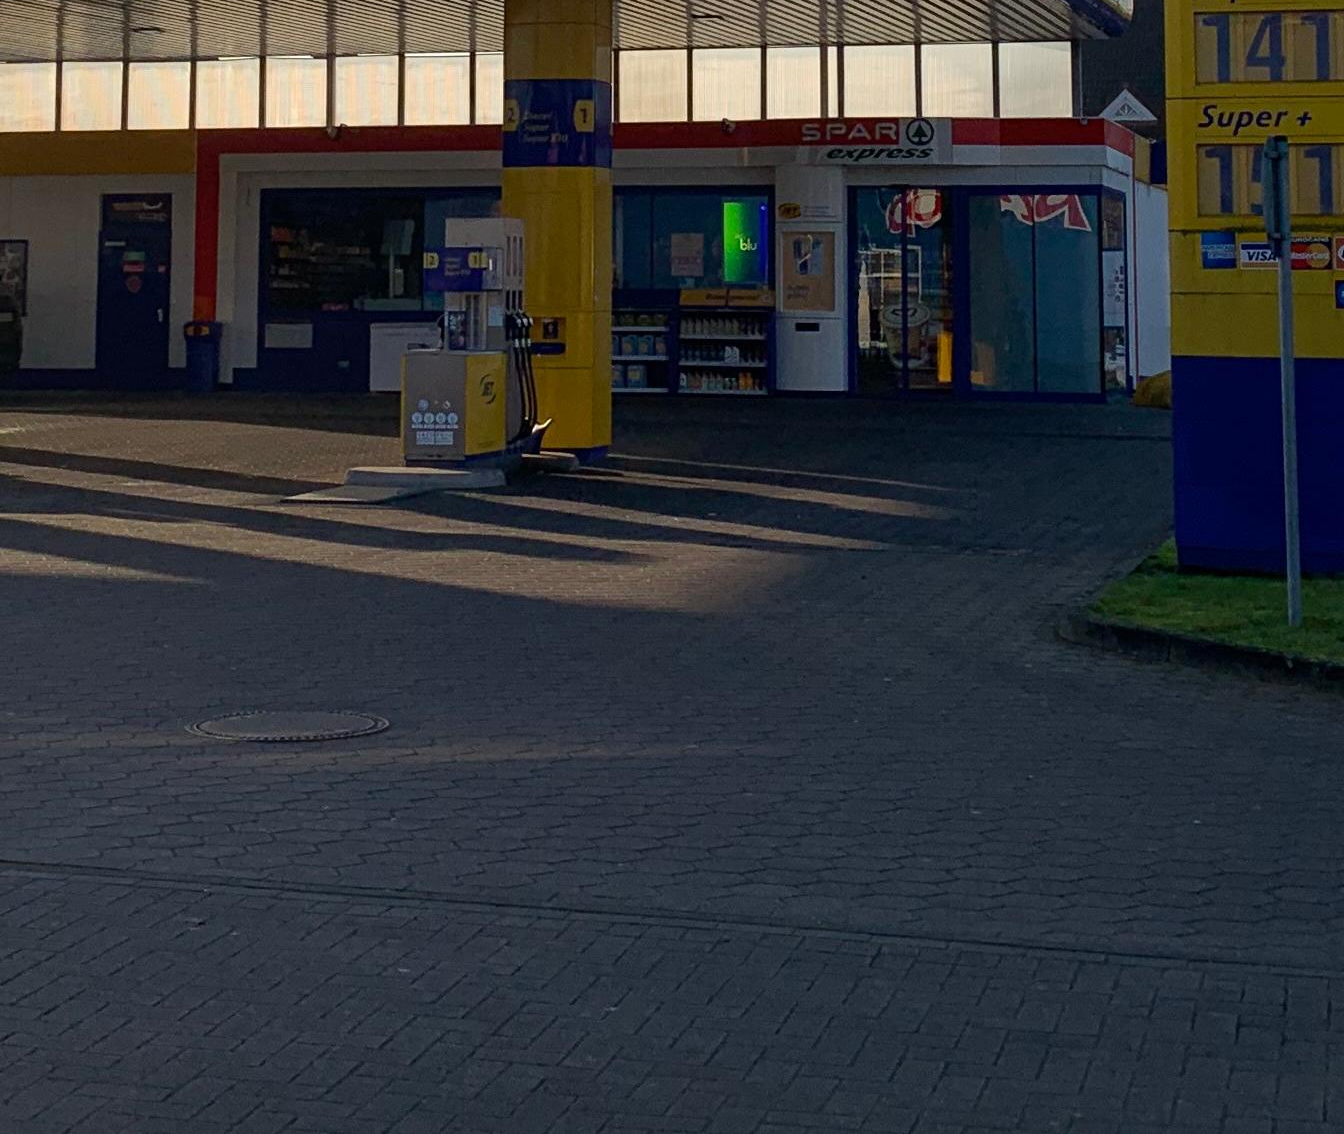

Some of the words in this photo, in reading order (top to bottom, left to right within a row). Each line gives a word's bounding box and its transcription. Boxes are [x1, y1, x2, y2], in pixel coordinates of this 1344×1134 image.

[1198, 104, 1288, 136] Super
[1296, 111, 1312, 126] +
[801, 122, 897, 142] SPAR
[826, 148, 934, 161] express
[1247, 250, 1278, 261] VISA
